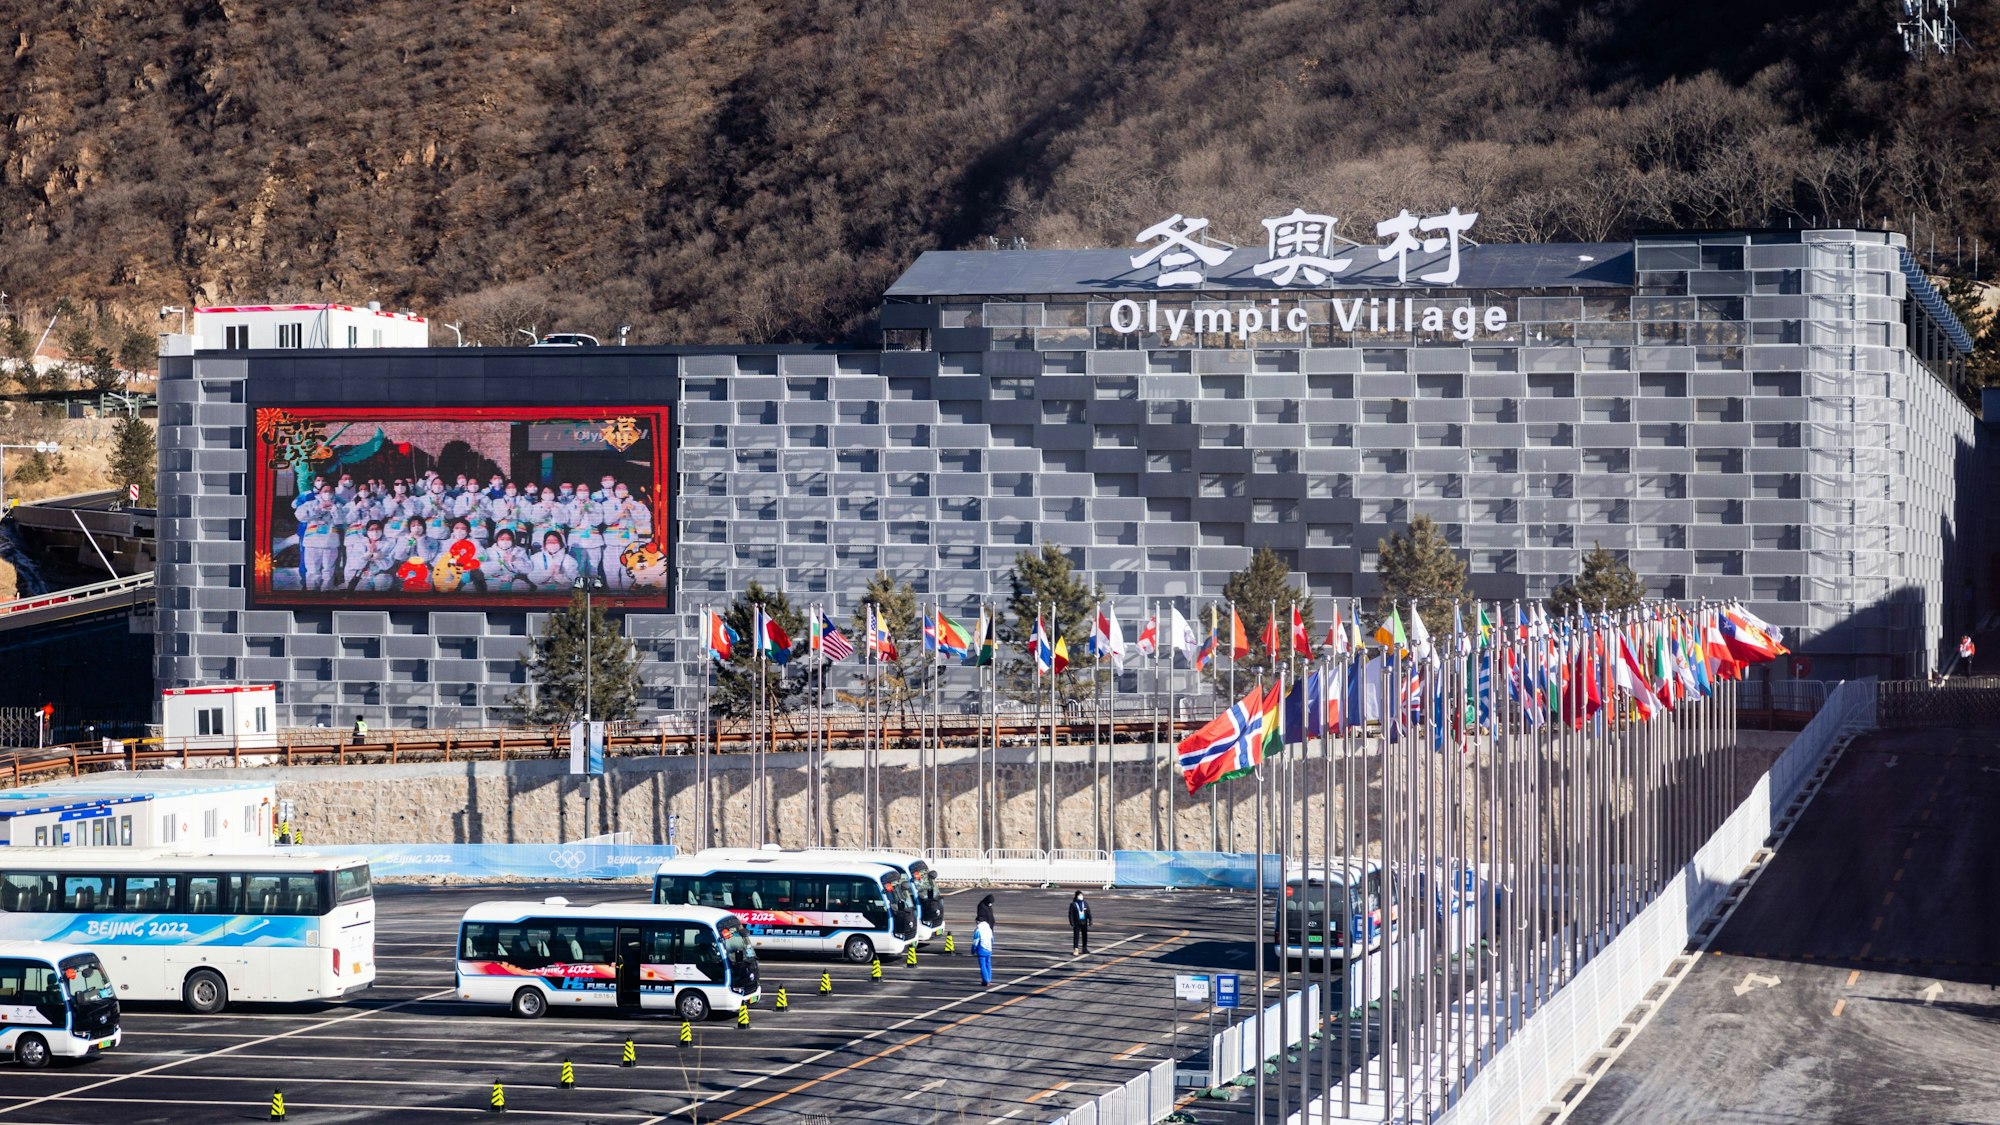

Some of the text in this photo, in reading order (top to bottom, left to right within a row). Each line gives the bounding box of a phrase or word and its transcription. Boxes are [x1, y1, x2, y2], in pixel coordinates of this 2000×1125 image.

[1130, 206, 1479, 287] 冬奥村
[1109, 297, 1509, 341] Olympic Village
[384, 854, 453, 866] BEIJING 2022
[606, 855, 643, 867] BEIJING
[751, 912, 777, 922] 2022
[87, 920, 189, 940] BEIJING 2022
[766, 928, 785, 936] FUEL
[804, 929, 821, 937] BUS
[567, 965, 596, 975] 2022
